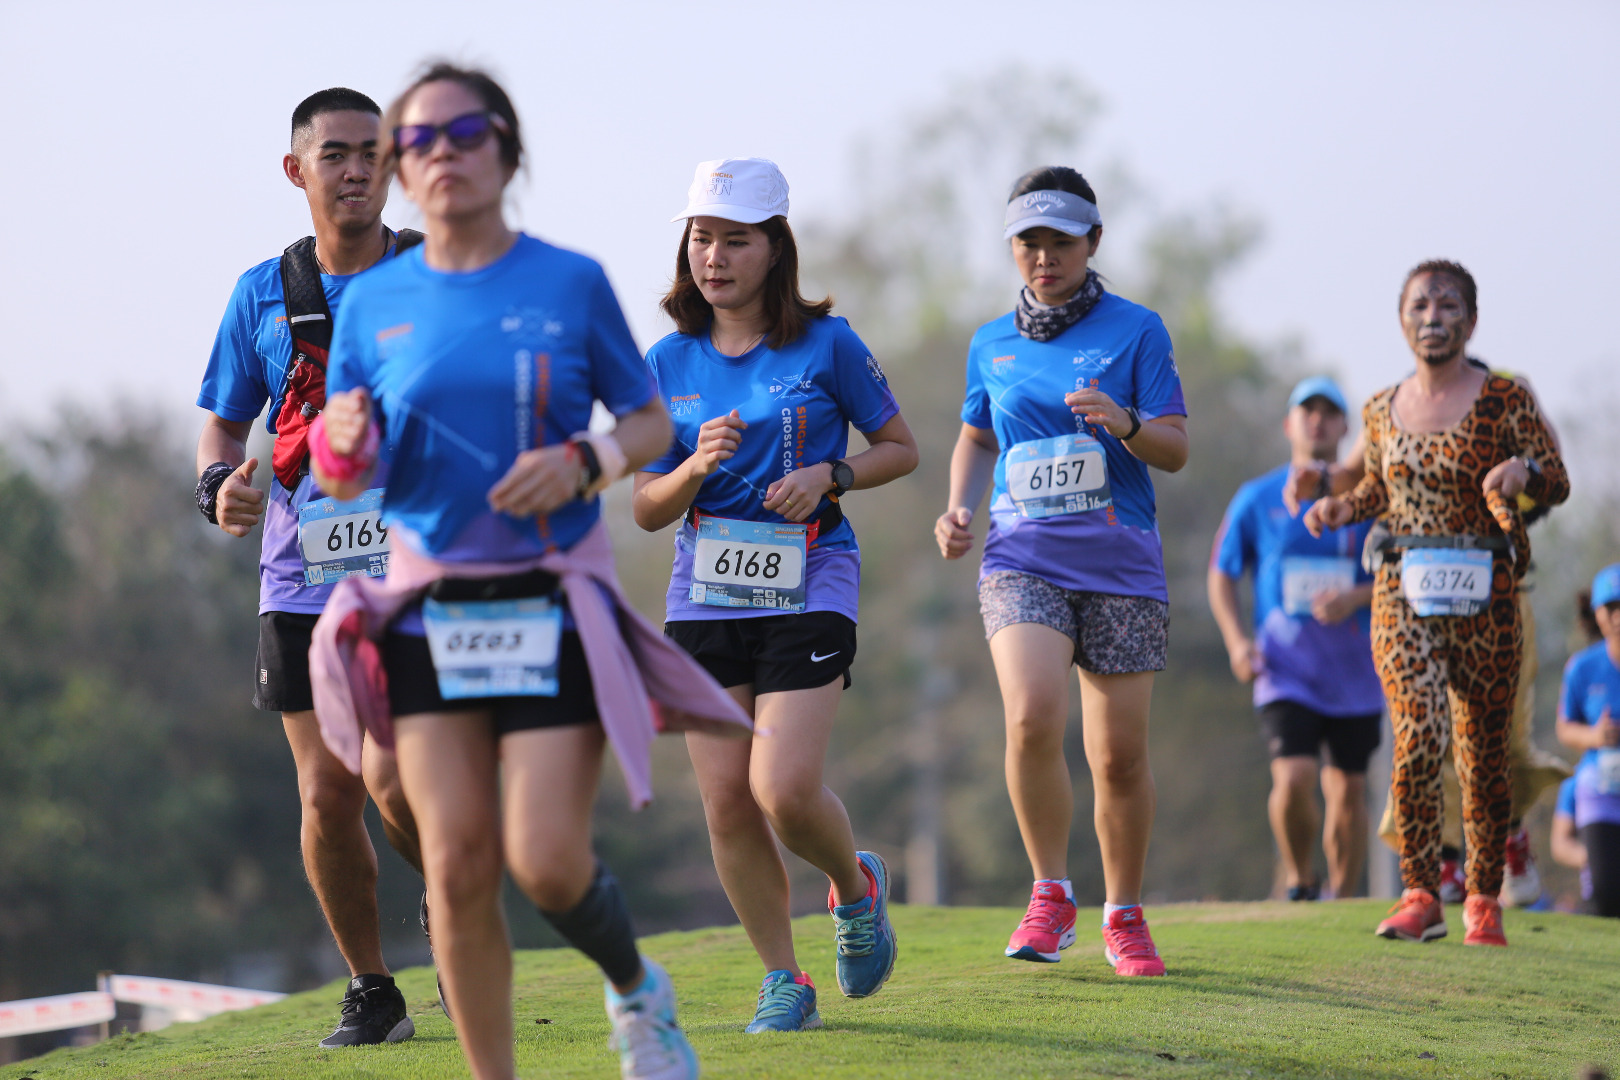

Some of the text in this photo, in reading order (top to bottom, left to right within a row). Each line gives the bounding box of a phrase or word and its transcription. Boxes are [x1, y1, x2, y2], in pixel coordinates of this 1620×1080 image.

[1023, 192, 1066, 209] Callaway
[671, 393, 701, 402] SINGHA
[769, 379, 812, 393] SP XC
[781, 407, 792, 448] CROSS
[795, 406, 807, 459] SINGHA
[1030, 459, 1085, 490] 6157
[327, 519, 388, 551] 6169
[714, 548, 782, 579] 6168
[1420, 568, 1475, 592] 6374
